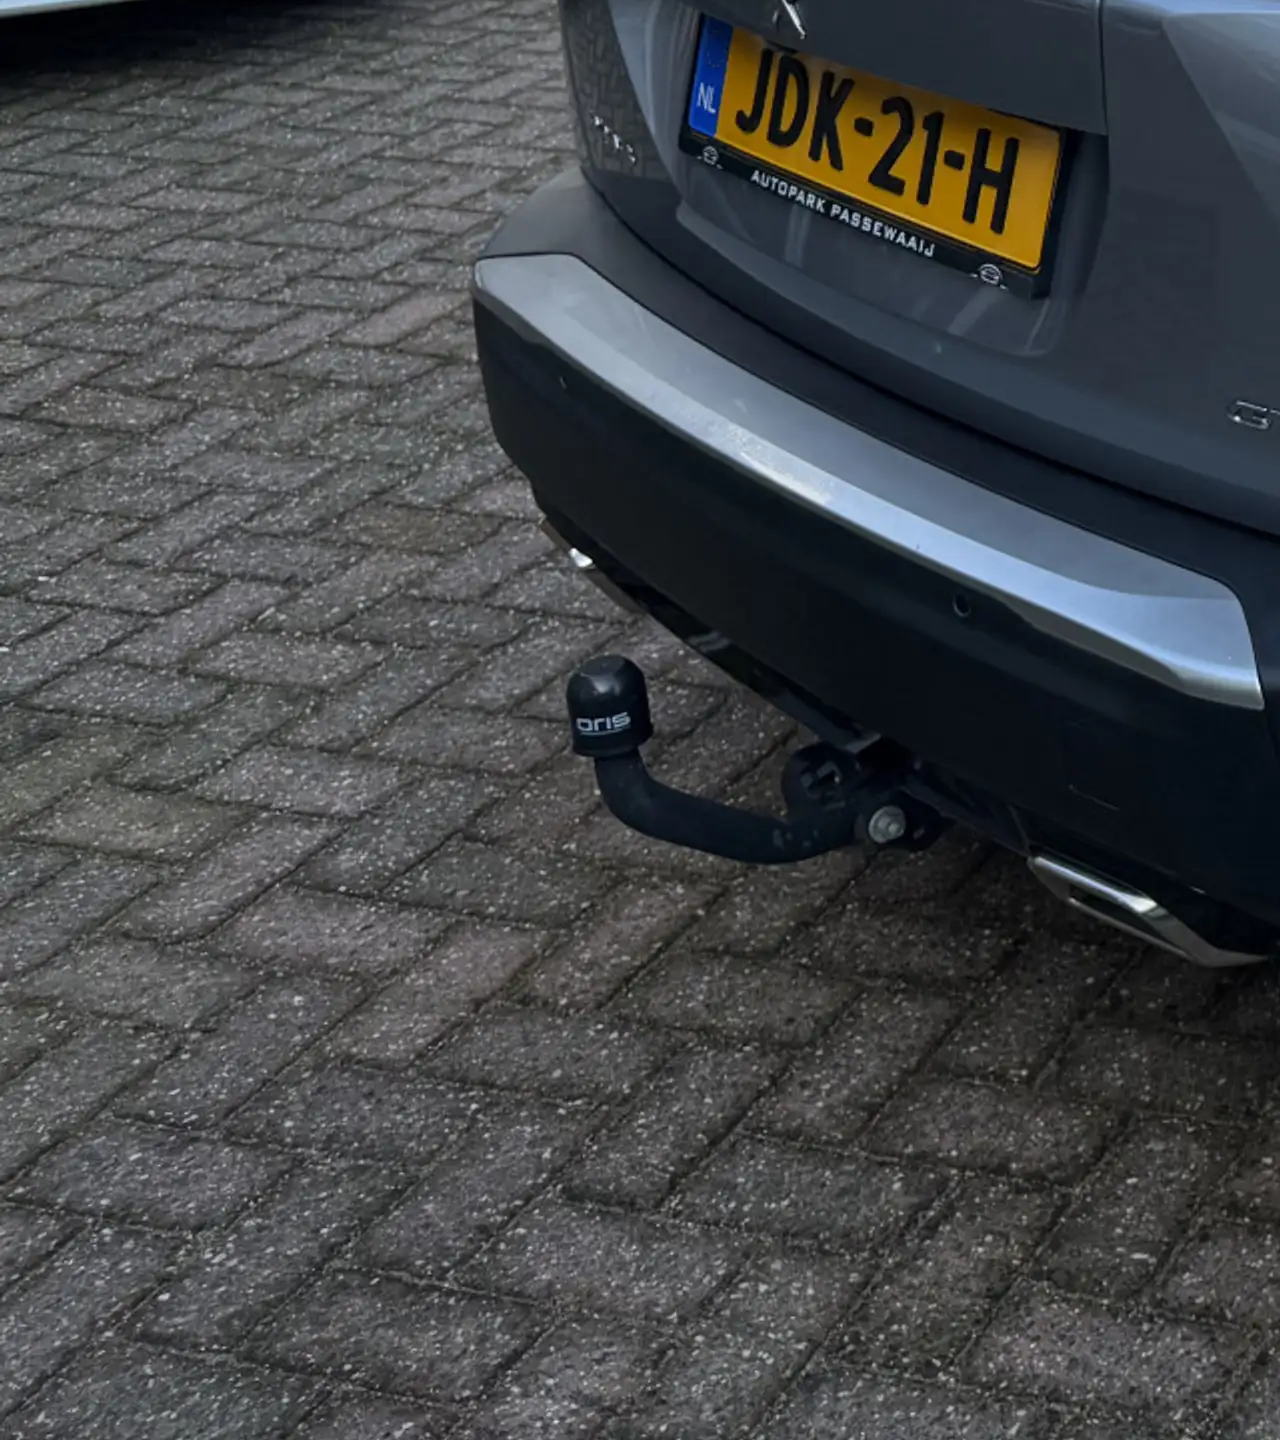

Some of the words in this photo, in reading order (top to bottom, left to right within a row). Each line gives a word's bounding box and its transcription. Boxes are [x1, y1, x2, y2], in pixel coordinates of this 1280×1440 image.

[696, 81, 717, 116] NL
[734, 47, 1021, 235] JDK-21-H
[750, 169, 827, 214] AUTOPARK
[829, 203, 937, 259] PASSEWAAIJ
